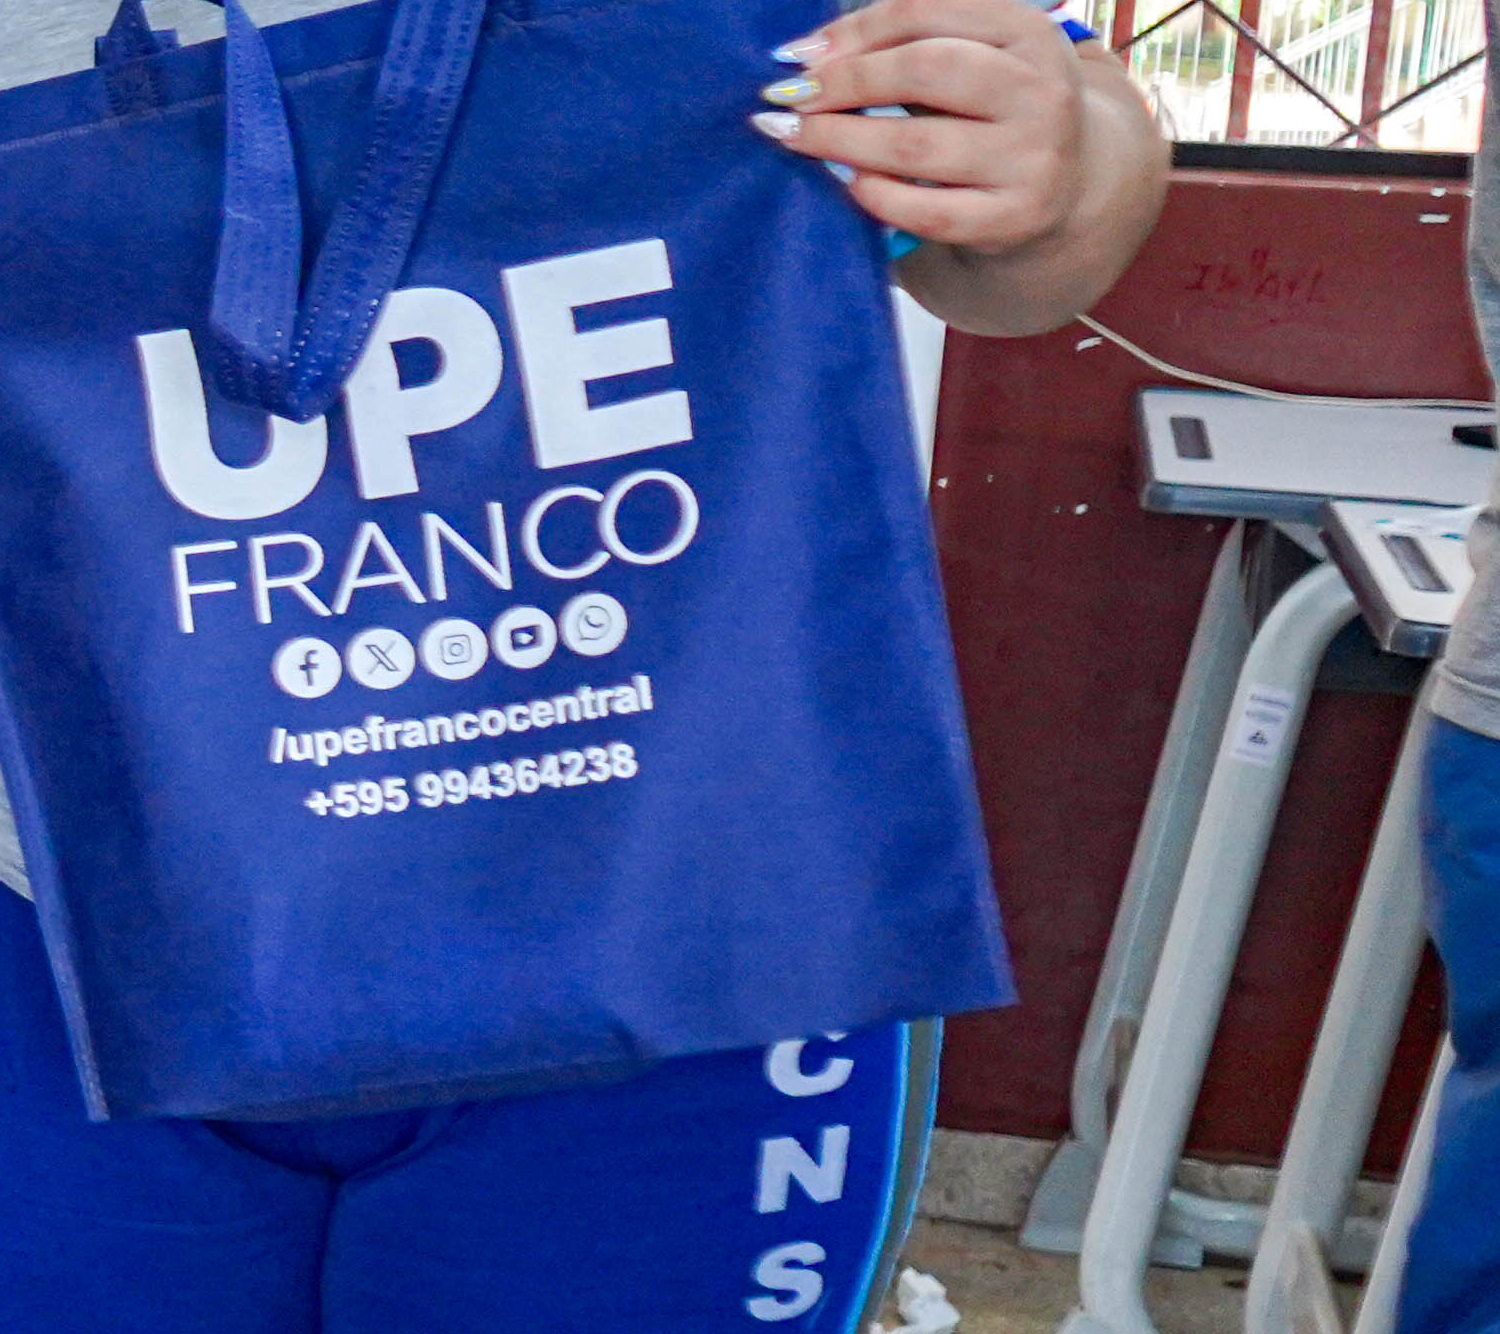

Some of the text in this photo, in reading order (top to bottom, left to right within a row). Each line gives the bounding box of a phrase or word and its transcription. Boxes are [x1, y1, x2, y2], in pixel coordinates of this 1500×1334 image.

[171, 469, 699, 634] FRANCO
[270, 676, 654, 767] /upefrancocentral
[306, 743, 638, 819] +595 994364238
